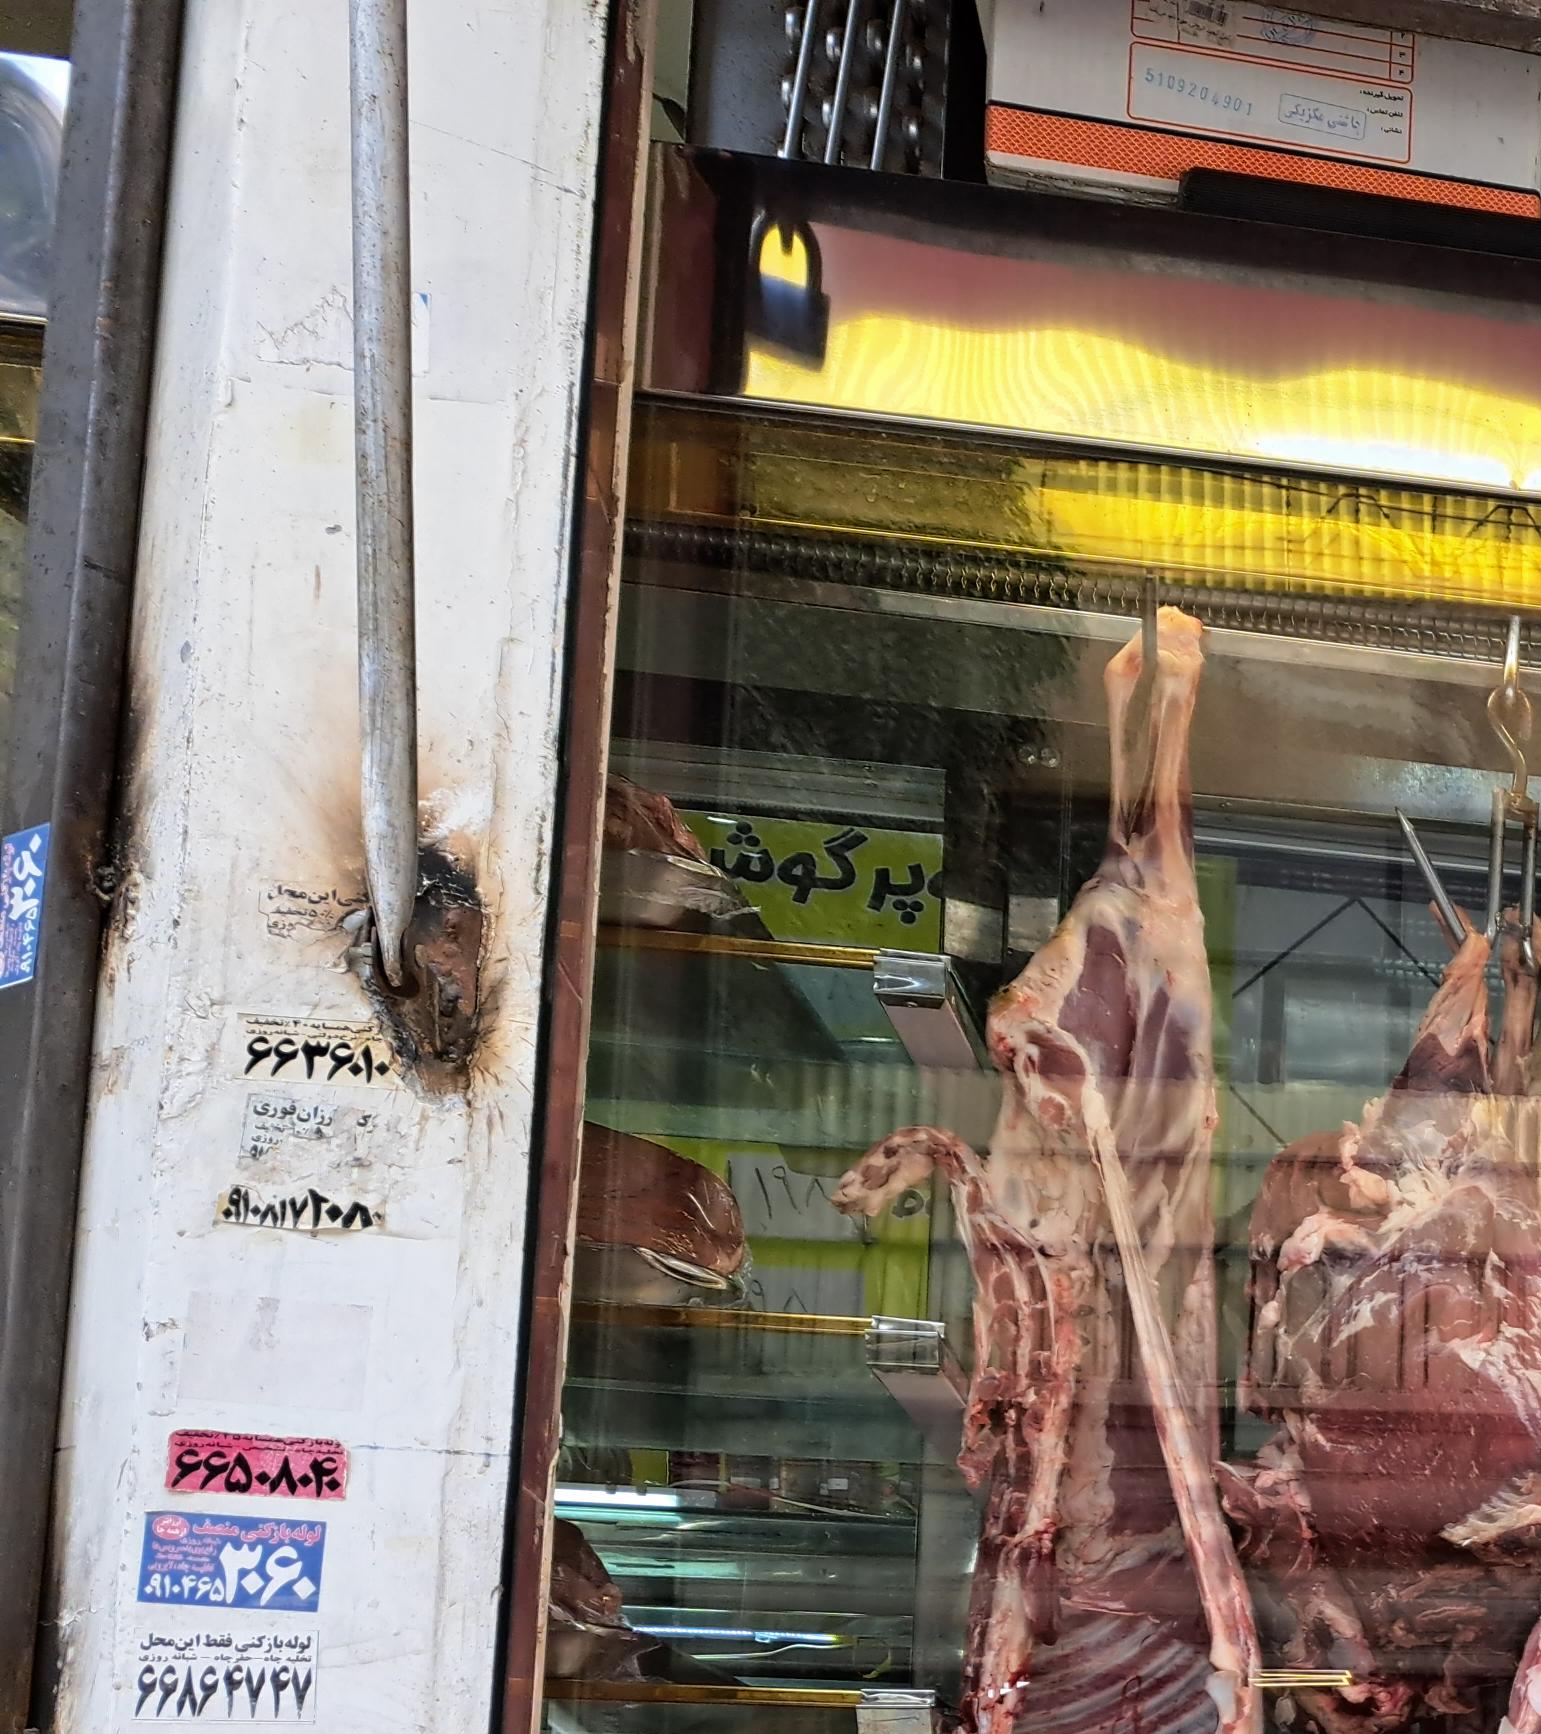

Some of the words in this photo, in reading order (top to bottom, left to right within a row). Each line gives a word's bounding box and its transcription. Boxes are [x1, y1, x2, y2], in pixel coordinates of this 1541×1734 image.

[243, 1035, 391, 1085] ۶۶۳۶۰۱۰
[253, 1100, 297, 1120] فوری
[296, 1104, 333, 1128] رزان
[171, 1449, 341, 1498] ۶۶۵۰۸۰۴۰
[219, 1541, 317, 1607] ۳۰۶۰
[144, 1573, 225, 1602] ۰۹۱۰۴۶۵
[203, 1633, 233, 1648] فقط
[234, 1635, 285, 1653] بازکنی
[285, 1635, 312, 1655] لوله
